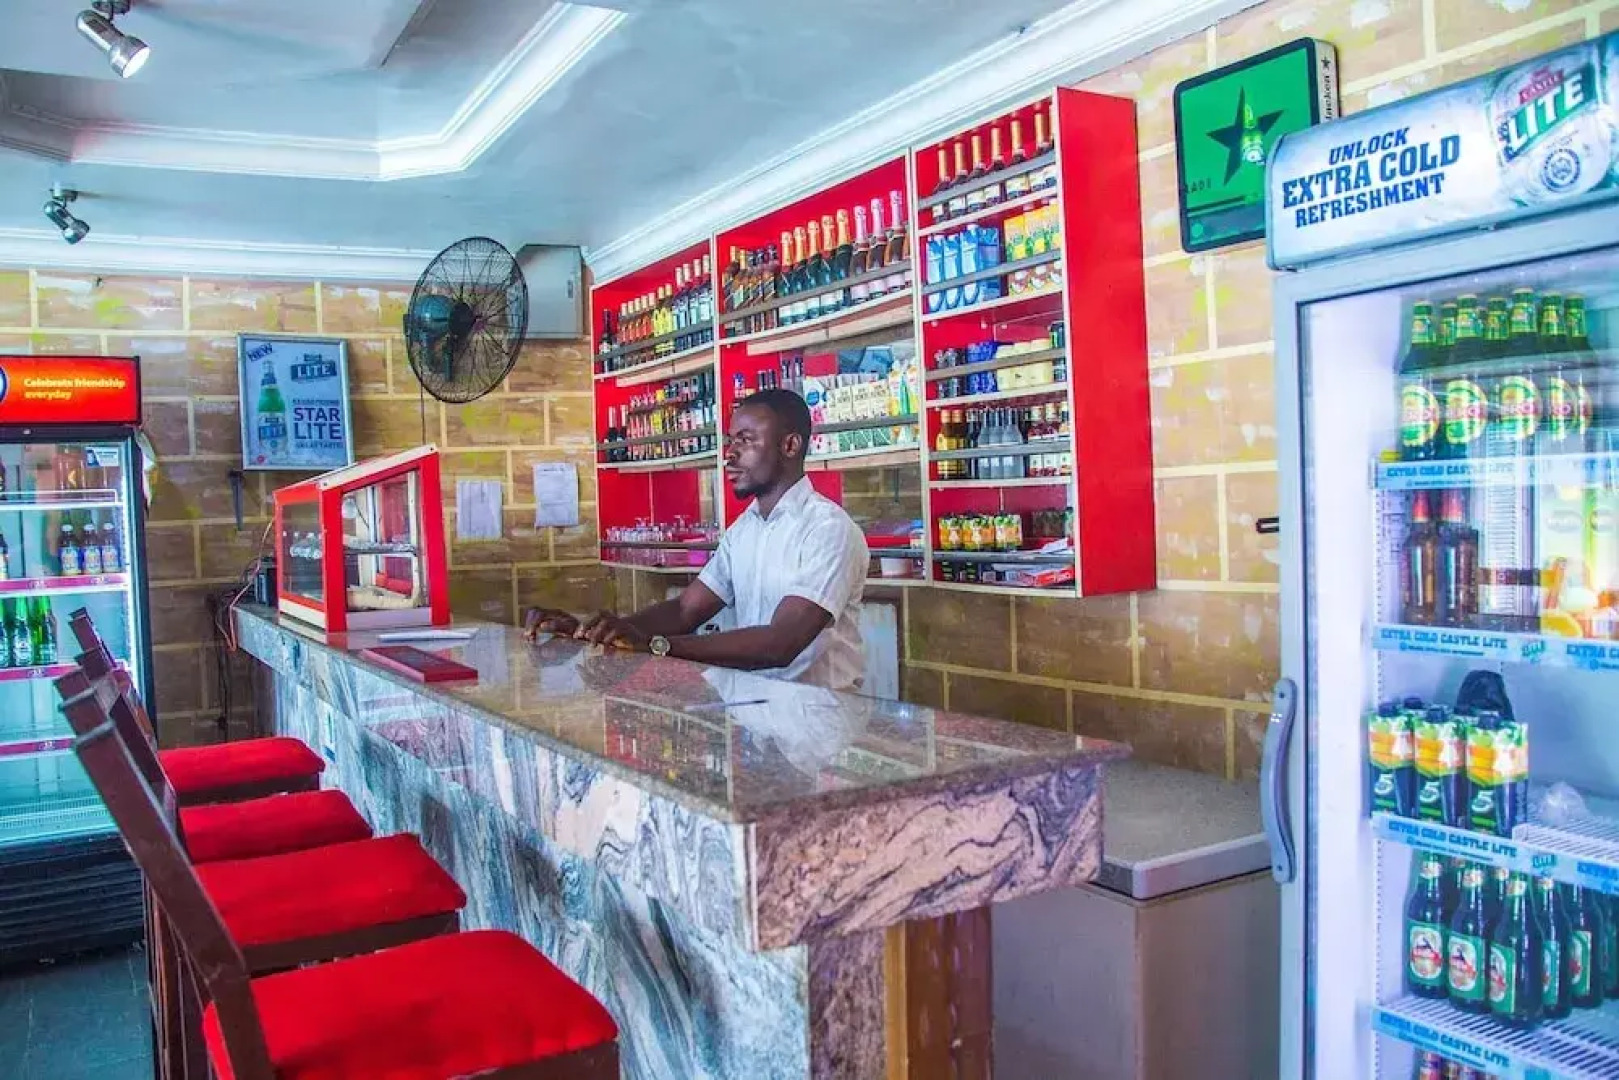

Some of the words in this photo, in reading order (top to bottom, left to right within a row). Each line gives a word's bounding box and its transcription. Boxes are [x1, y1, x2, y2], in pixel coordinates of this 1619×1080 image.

[1508, 72, 1584, 151] LITE
[1329, 125, 1410, 165] UNLOCK
[1282, 160, 1371, 209] EXTRA
[1380, 134, 1460, 182] COLD
[1296, 172, 1444, 228] REFRESHMENT
[247, 342, 273, 361] NEW
[297, 361, 334, 377] LITE
[24, 378, 73, 388] Celebrate
[74, 378, 126, 389] friendship
[25, 390, 72, 400] everyday
[294, 407, 341, 422] STAR
[294, 422, 342, 440] LITE
[1441, 633, 1480, 646] CASTLE
[1483, 636, 1507, 649] LITE
[1374, 773, 1394, 795] 5
[1419, 781, 1440, 803] 5
[1471, 790, 1494, 813] 5
[1449, 834, 1489, 851] CASTLE
[1491, 843, 1518, 858] LITE
[1440, 1033, 1482, 1055] CASTLE
[1484, 1048, 1510, 1067] LITE
